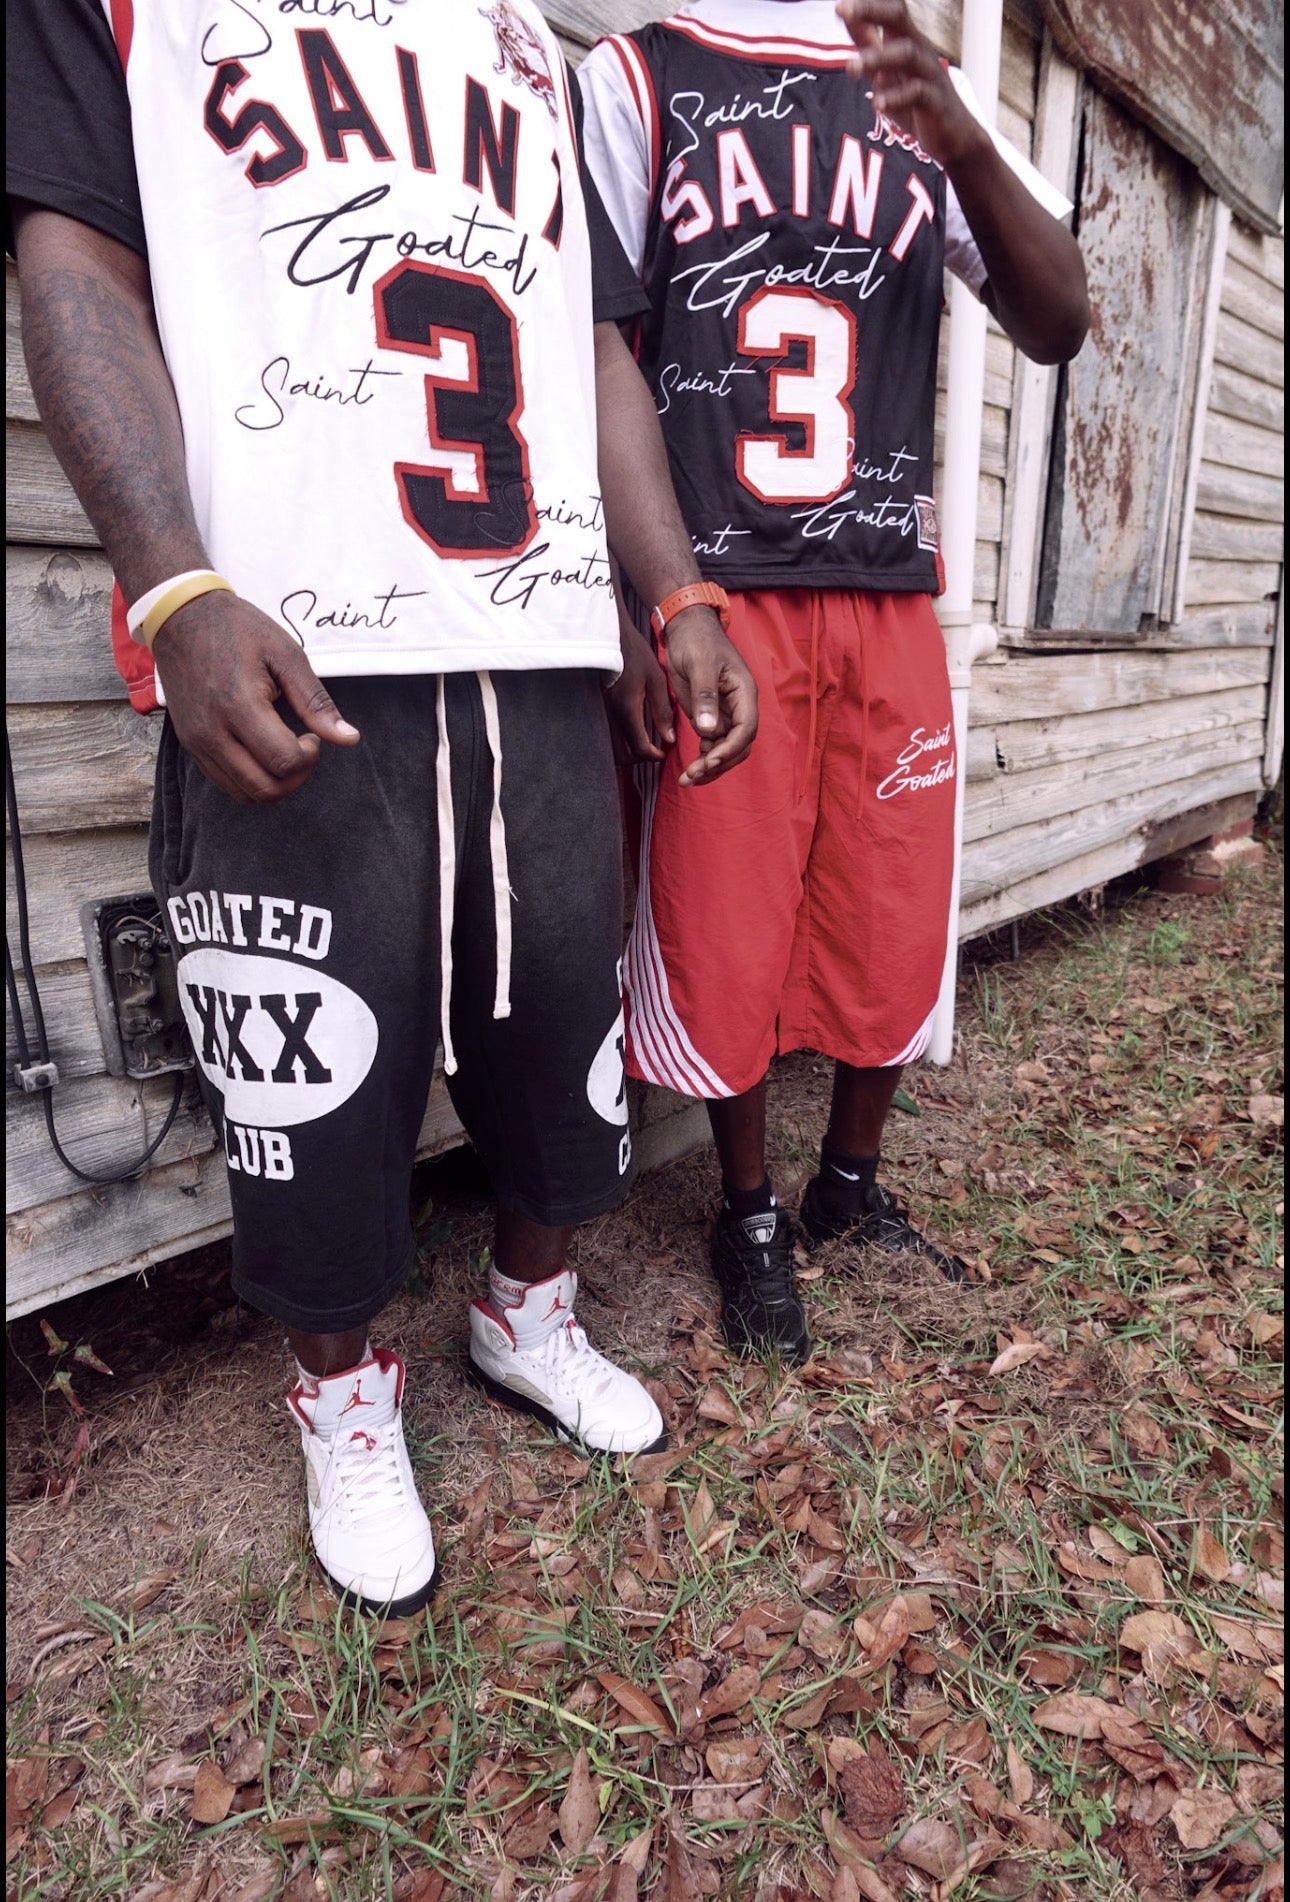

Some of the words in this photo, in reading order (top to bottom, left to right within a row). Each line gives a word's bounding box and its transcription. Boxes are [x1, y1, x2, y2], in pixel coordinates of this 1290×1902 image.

[666, 69, 816, 169] Saint
[660, 124, 935, 262] SAINT
[260, 184, 537, 295] Goated
[670, 231, 885, 318] Goated
[234, 356, 403, 430] Saint
[373, 257, 541, 560] 3
[652, 362, 757, 415] Saint
[735, 284, 857, 506] 3
[790, 489, 916, 540] Goated
[876, 751, 955, 800] Goated
[896, 721, 952, 765] Saint
[167, 889, 333, 961] GOATED
[185, 983, 333, 1085] XXX
[222, 1115, 295, 1182] LUB
